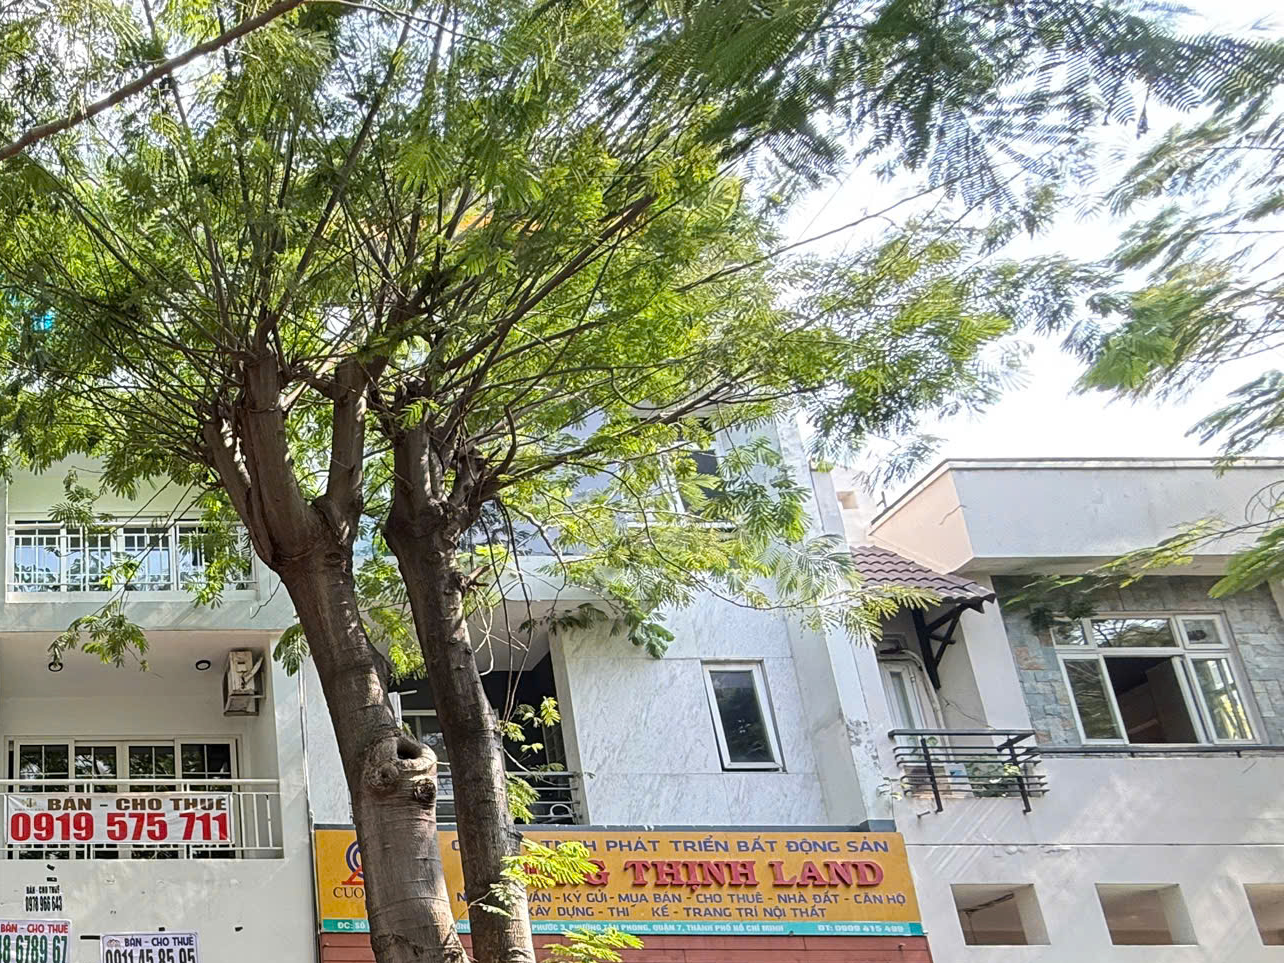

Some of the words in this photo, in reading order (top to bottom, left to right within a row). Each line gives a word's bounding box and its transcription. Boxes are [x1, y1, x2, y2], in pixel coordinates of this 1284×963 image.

[47, 796, 92, 811] BÁN
[115, 797, 162, 811] CHO
[10, 812, 94, 841] 0919
[106, 812, 168, 841] 575
[179, 812, 228, 841] 711
[605, 836, 660, 852] PHÁT
[669, 834, 730, 853] TRIỂN
[785, 838, 841, 855] ĐỘNG
[624, 860, 759, 892] THỊNH
[768, 860, 885, 887] LAND
[333, 886, 364, 899] CUO
[653, 890, 682, 904] BÁN
[695, 892, 723, 904] CHO
[729, 890, 763, 904] THUÊ
[777, 891, 808, 904] NHÀ
[557, 906, 594, 919] DỰNG
[683, 906, 732, 918] TRANG
[1, 921, 18, 933] BÁN
[27, 923, 45, 933] CHO
[151, 937, 170, 946] CHO
